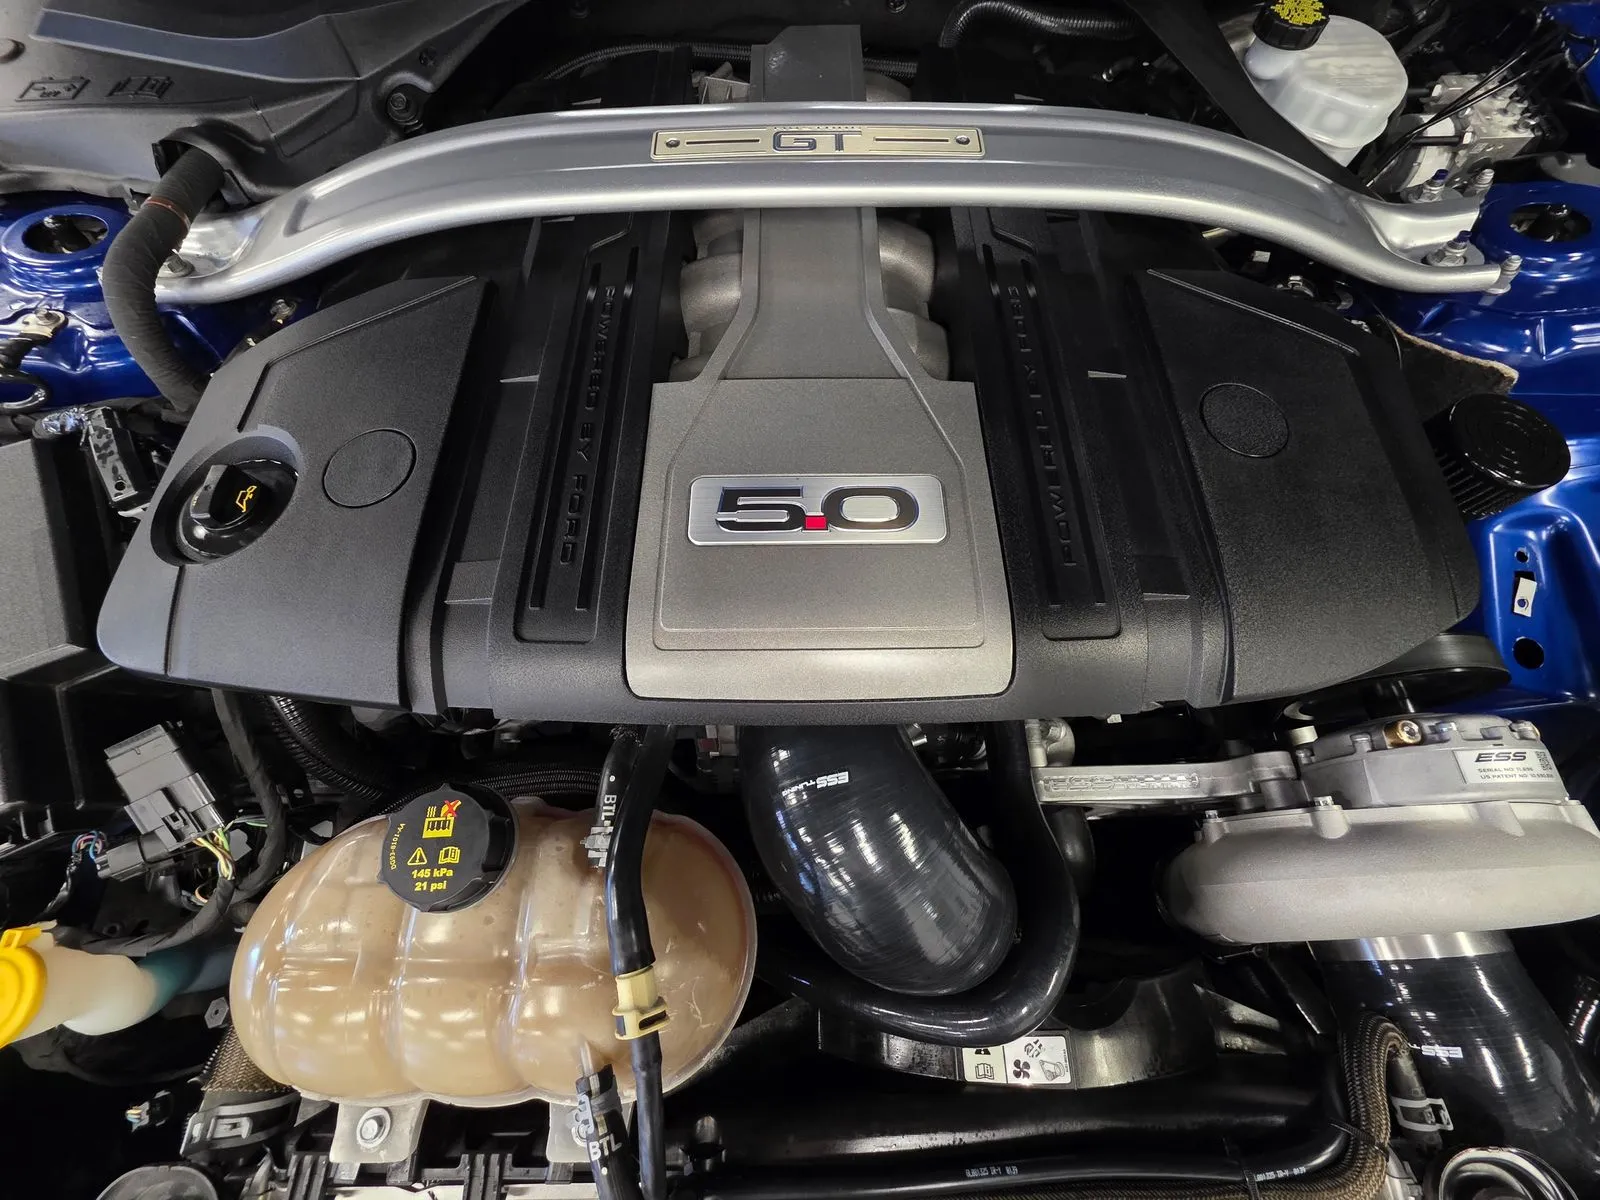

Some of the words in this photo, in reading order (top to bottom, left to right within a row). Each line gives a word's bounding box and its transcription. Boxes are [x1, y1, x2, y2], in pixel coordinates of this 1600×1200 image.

[772, 130, 863, 152] GT
[715, 485, 920, 532] 5.0
[559, 474, 587, 566] FORD
[1474, 751, 1527, 763] ESS
[815, 771, 849, 789] ESS
[601, 794, 617, 821] BTL
[411, 869, 431, 879] 145
[433, 867, 454, 877] kPa
[414, 881, 427, 892] 21
[430, 880, 447, 892] psi
[589, 1133, 622, 1161] BTL
